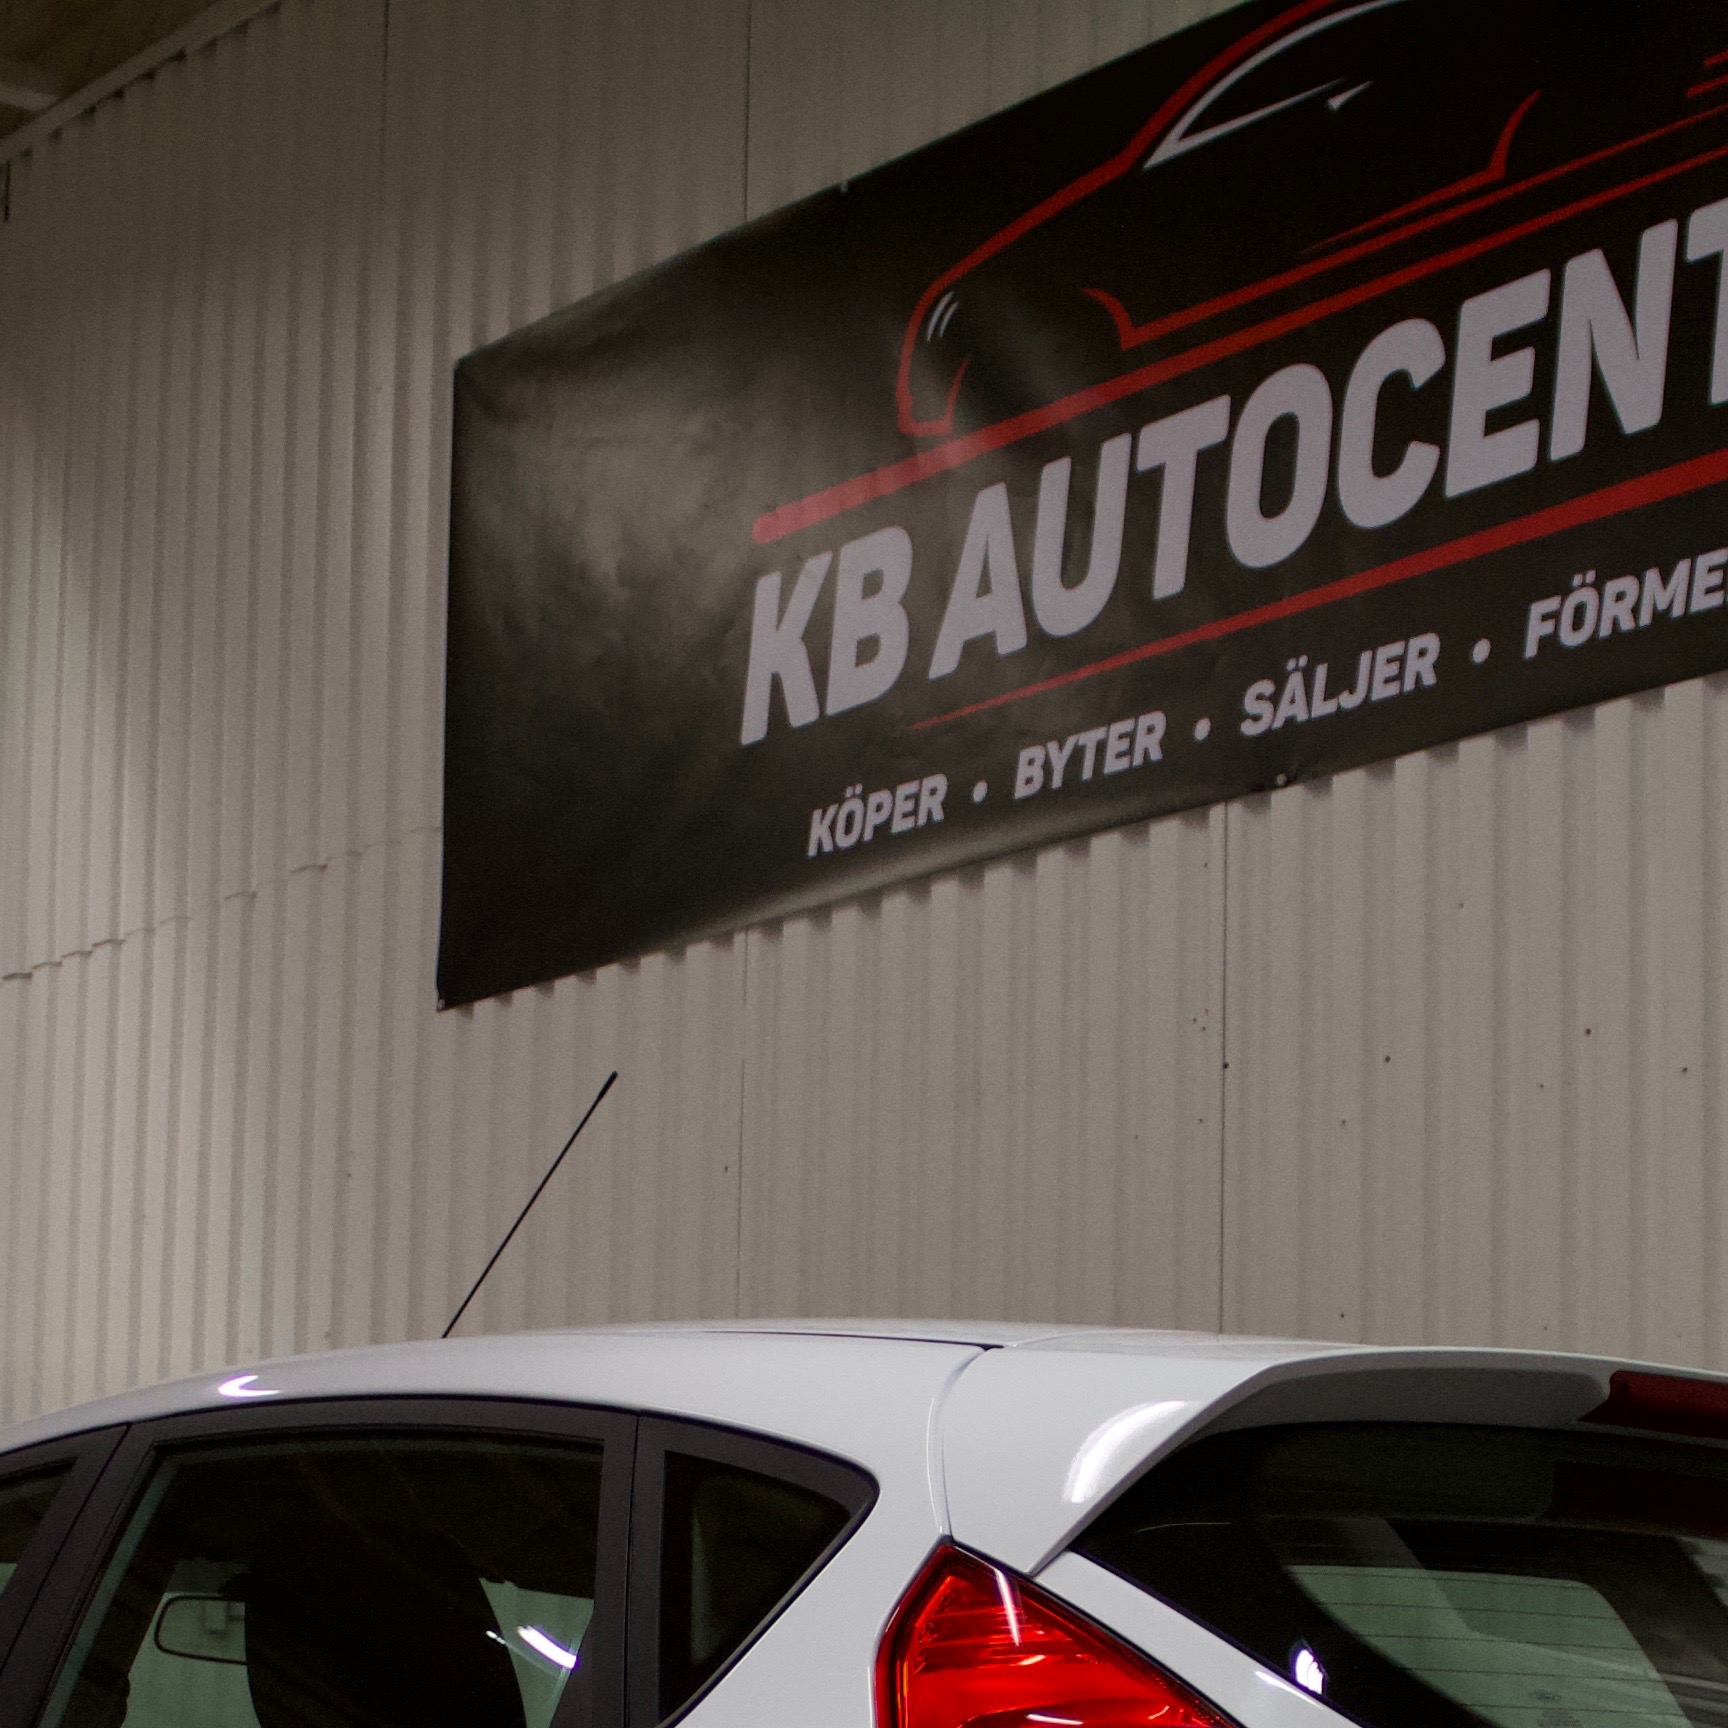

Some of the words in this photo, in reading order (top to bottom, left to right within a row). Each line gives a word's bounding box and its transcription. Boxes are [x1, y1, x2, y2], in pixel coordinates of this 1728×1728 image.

[739, 526, 916, 747] KB
[806, 772, 948, 858] KÖPER
[1013, 710, 1168, 799] BYTER
[1240, 632, 1441, 737] SÄLJER
